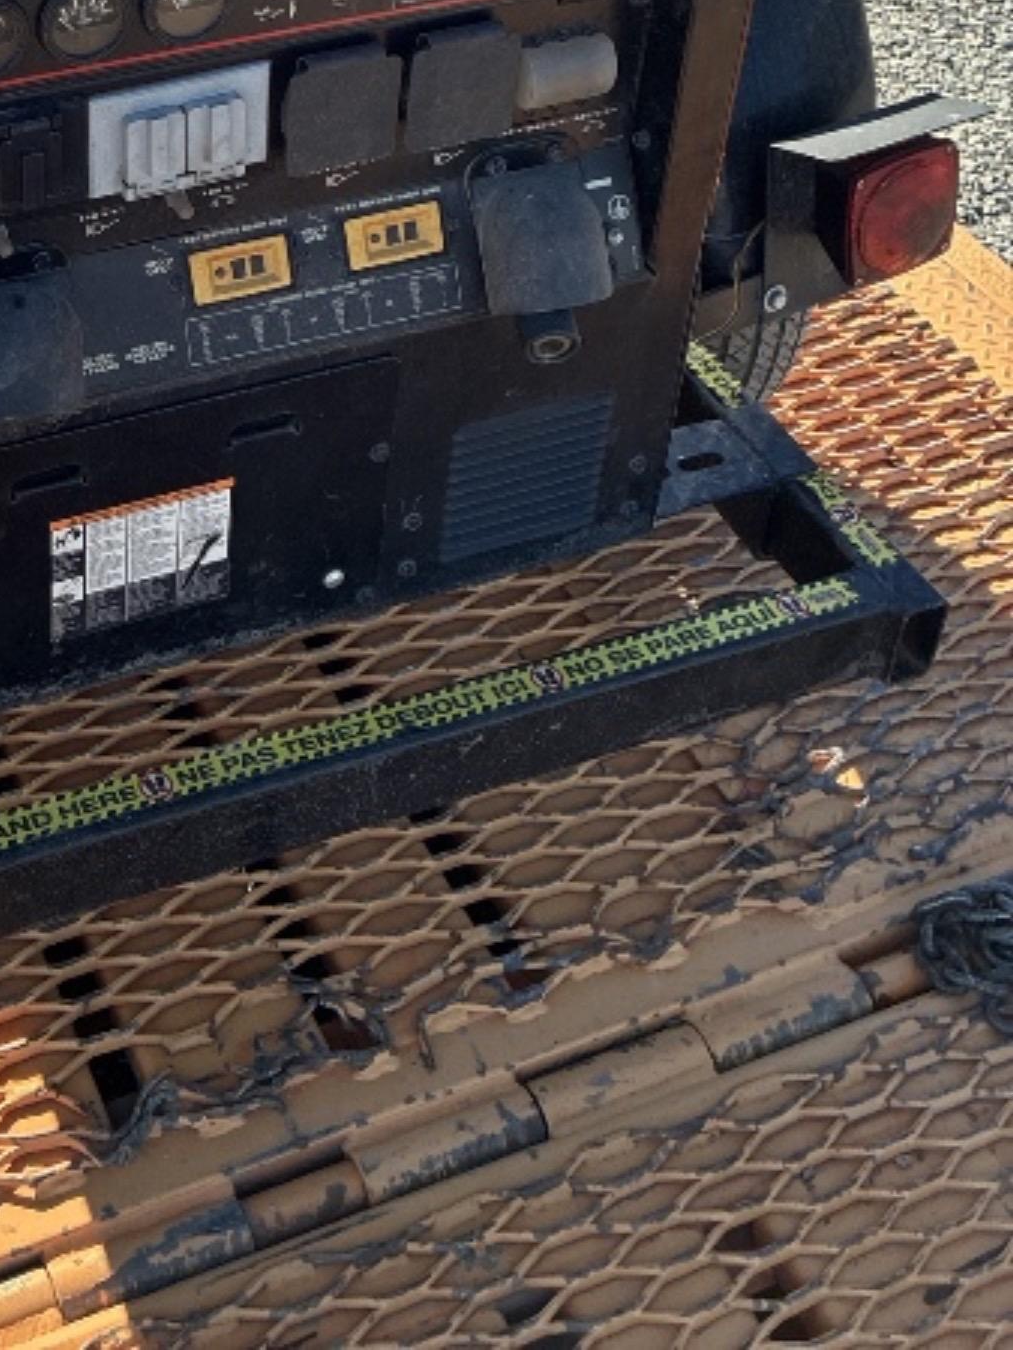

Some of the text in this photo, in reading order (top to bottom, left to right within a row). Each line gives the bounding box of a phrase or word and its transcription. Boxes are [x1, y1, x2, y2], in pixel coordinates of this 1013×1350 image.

[563, 655, 604, 678] NO
[177, 676, 529, 788] NE PAS TENEZ DEBOUT ICI
[58, 785, 138, 820] HERE
